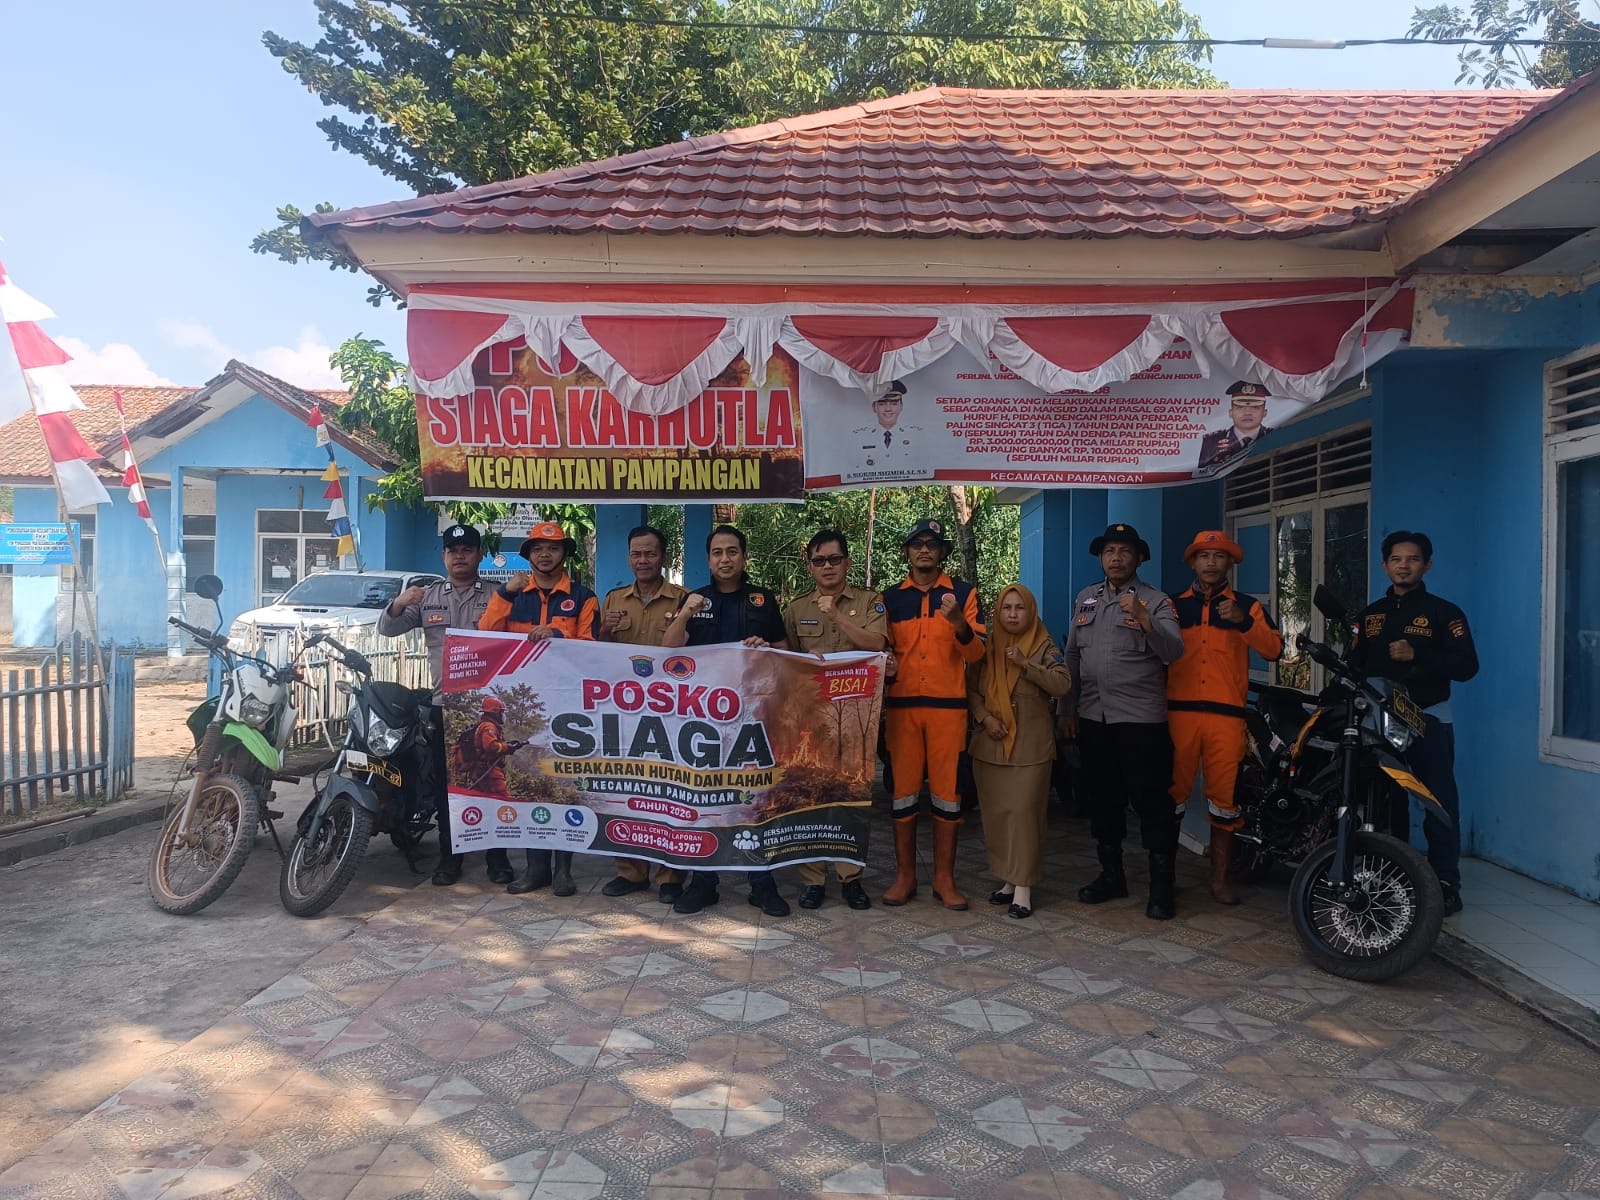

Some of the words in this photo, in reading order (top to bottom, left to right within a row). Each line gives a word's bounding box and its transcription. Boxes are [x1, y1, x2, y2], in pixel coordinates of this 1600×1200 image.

[935, 397, 972, 405] SETIAP
[973, 397, 1011, 405] ORANG
[1012, 397, 1041, 405] YANG
[1109, 398, 1182, 406] PEMBAKARAN
[1183, 398, 1221, 406] LAHAN
[943, 405, 1018, 413] SEBAGAIMANA
[1153, 406, 1166, 414] 69
[1167, 406, 1195, 414] AYAT
[427, 387, 562, 447] SIAGA
[963, 413, 998, 421] HURUF
[946, 421, 983, 429] PALING
[1074, 422, 1109, 430] TAHUN
[1136, 423, 1174, 431] PALING
[964, 430, 1017, 438] (SEPULUH)
[1081, 430, 1117, 438] DENDA
[1119, 431, 1157, 439] PALING
[1071, 438, 1098, 447] (TIGA
[1100, 439, 1135, 447] MILIAR
[1136, 440, 1180, 448] RUPIAH)
[990, 446, 1027, 454] PALING
[1029, 446, 1071, 454] BANYAK
[1060, 455, 1094, 463] MILIAR
[1096, 456, 1140, 465] RUPIAH)
[467, 455, 608, 491] KECAMATAN
[612, 457, 761, 491] PAMPANGAN
[990, 472, 1064, 481] KECAMATAN
[1067, 473, 1144, 483] PAMPANGAN
[450, 645, 470, 654] CEGAH
[449, 653, 479, 662] KARHUTLA
[449, 660, 487, 671] SELAMATKAN
[465, 670, 479, 679] KITA
[855, 668, 869, 676] KITA
[829, 677, 868, 694] BISA!
[582, 679, 741, 722] POSKO
[551, 713, 775, 769] SIAGA
[553, 761, 645, 777] KEBAKARAN
[648, 764, 691, 785] HUTAN
[693, 772, 724, 788] DAN
[727, 771, 773, 788] LAHAN
[592, 779, 662, 796] KECAMATAN
[666, 787, 735, 804] PAMPANGAN
[634, 800, 670, 812] TAHUN
[669, 806, 692, 819] 2026
[632, 824, 647, 832] CALL
[671, 831, 703, 842] LAPORAN
[763, 826, 794, 838] BERSAMA
[794, 824, 842, 832] MASYARAKAT
[763, 837, 779, 847] KITA
[817, 832, 856, 842] KARHUTLA
